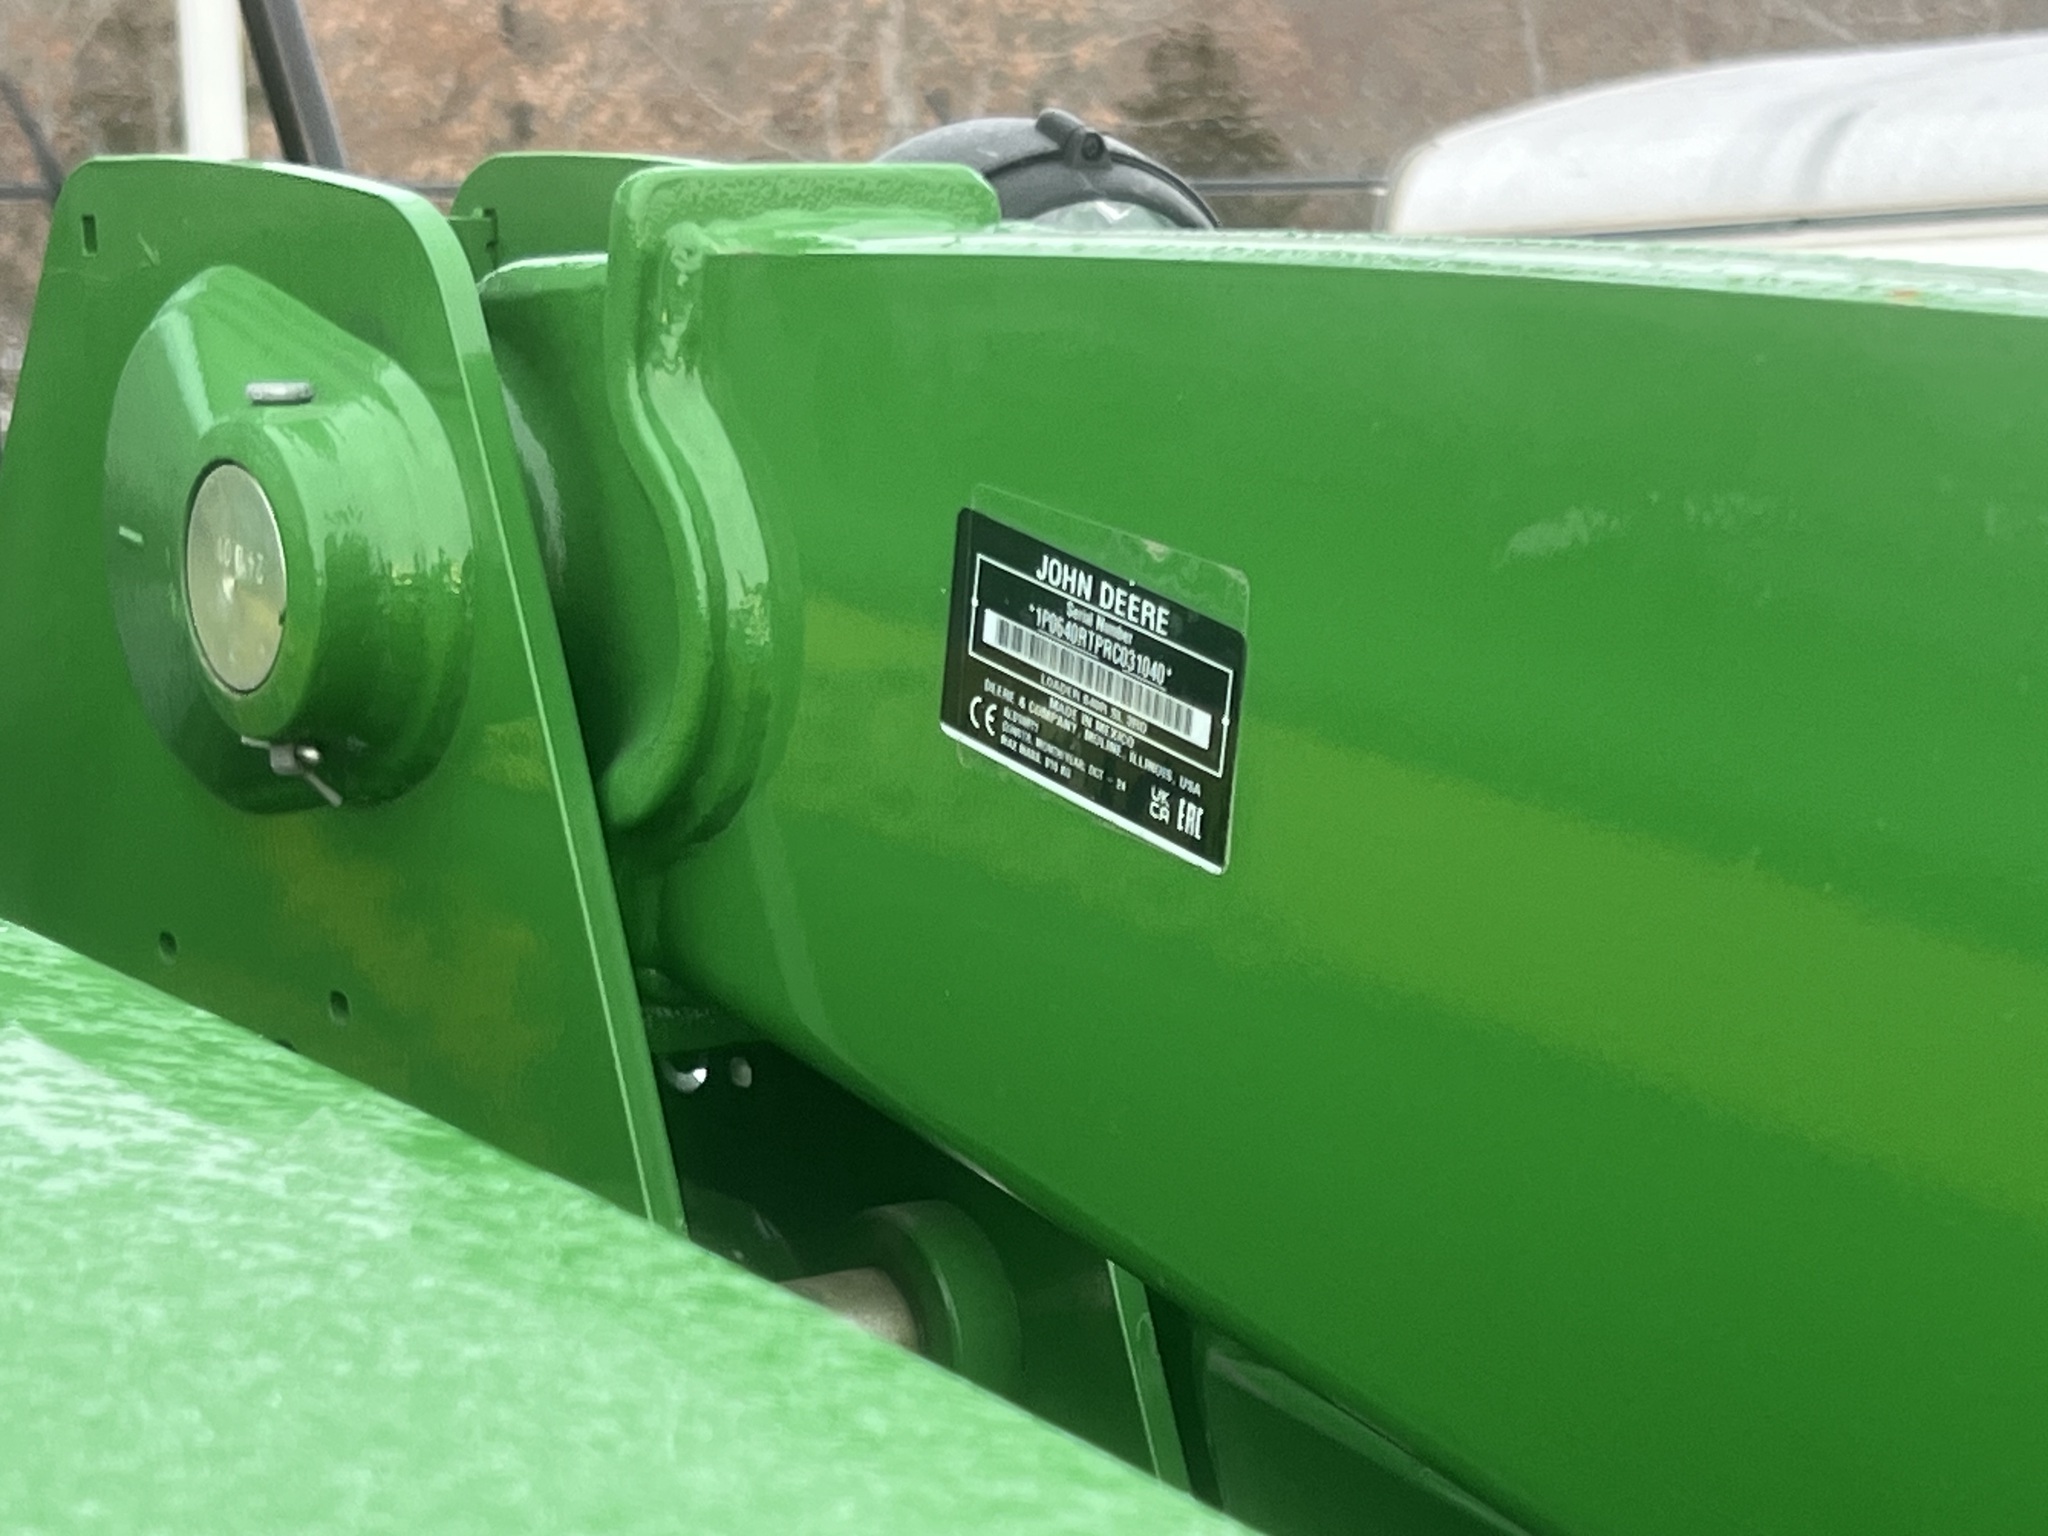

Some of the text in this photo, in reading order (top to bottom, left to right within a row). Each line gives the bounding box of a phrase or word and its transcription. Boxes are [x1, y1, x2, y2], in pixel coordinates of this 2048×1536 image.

[1036, 554, 1170, 636] JOHN DEERE
[1095, 614, 1133, 645] Number
[1040, 673, 1080, 702] LOADER
[984, 678, 1014, 704] DEERE
[1018, 696, 1026, 710] &
[1179, 775, 1201, 798] USA
[1049, 697, 1078, 721] MADE
[1081, 712, 1093, 729] IN
[1095, 719, 1135, 749] MEXICO
